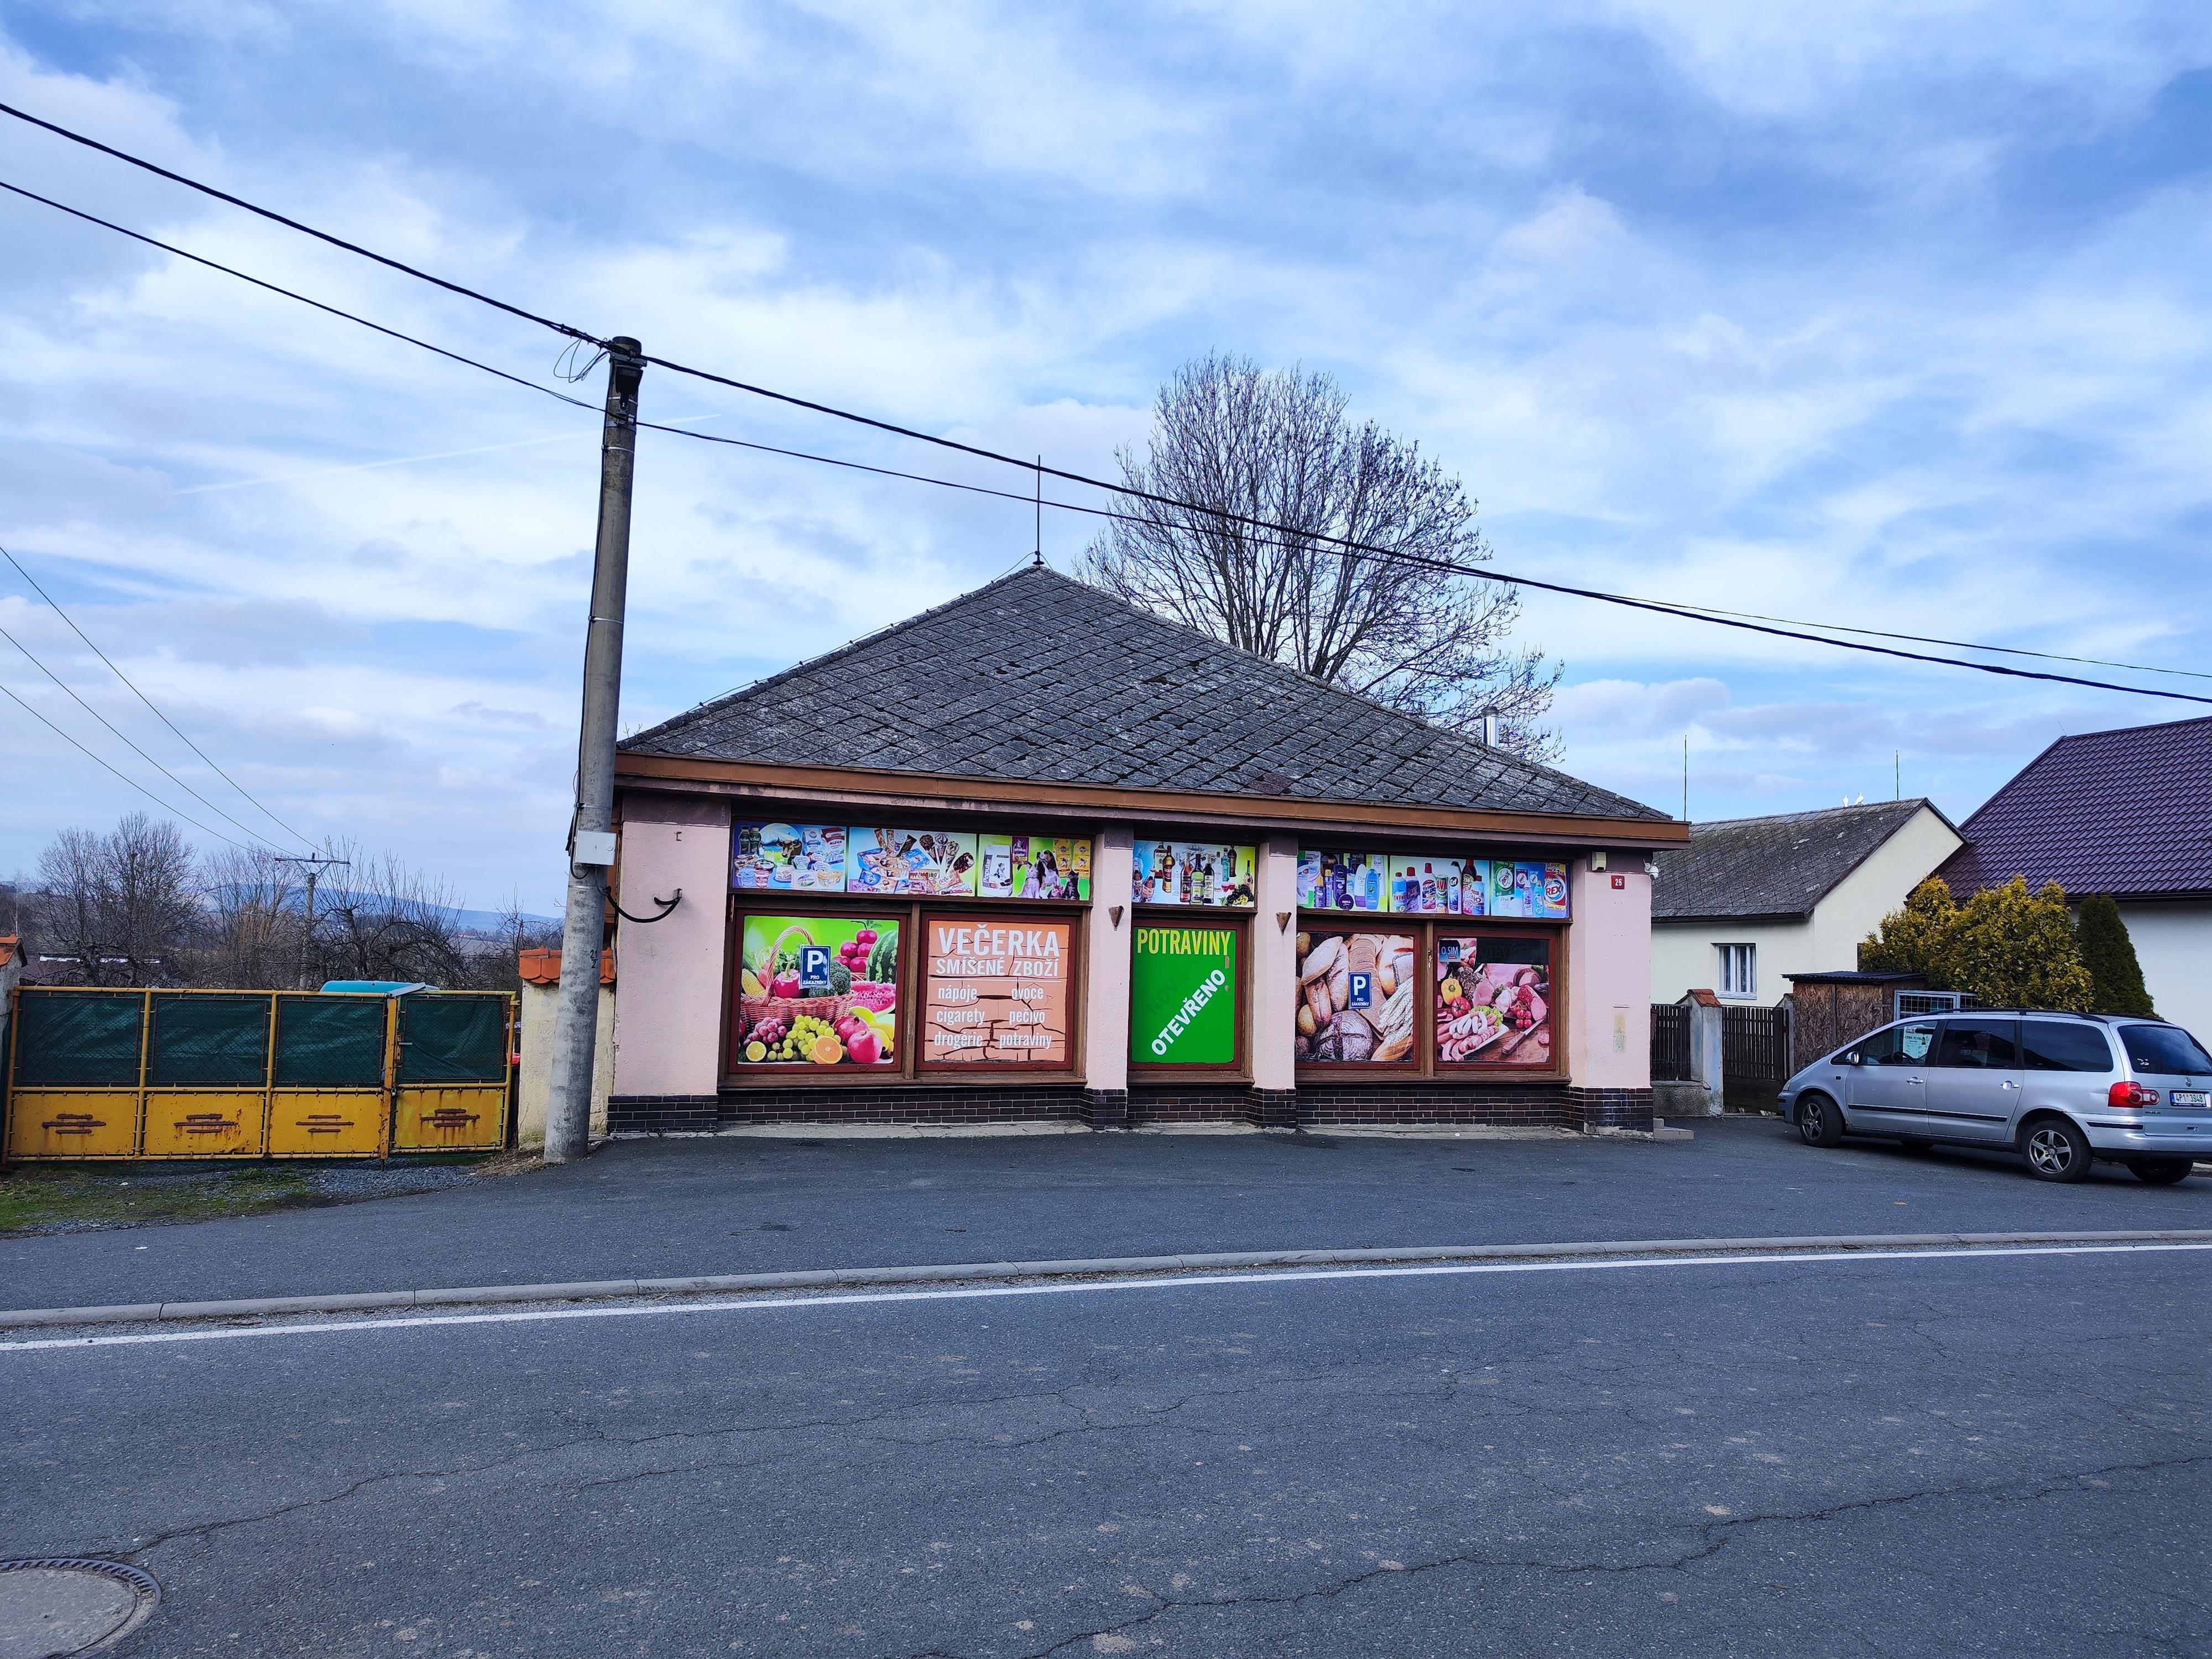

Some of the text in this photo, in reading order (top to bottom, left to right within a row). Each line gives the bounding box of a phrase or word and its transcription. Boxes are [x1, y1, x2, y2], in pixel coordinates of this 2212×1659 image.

[1546, 885, 1561, 895] REX
[938, 924, 1060, 957] VEČERKA
[1138, 929, 1231, 956] POTRAVINY
[590, 949, 597, 959] 21
[1448, 946, 1458, 955] SIM
[807, 950, 823, 972] P
[936, 956, 1059, 977] SMÍŠENÉ ZBOŽÍ
[938, 985, 1044, 1003] nápoje ovoce
[1354, 976, 1366, 995] P
[936, 1008, 1045, 1026] cigarety pečivo
[1151, 969, 1225, 1055] OTEVŘENO
[934, 1031, 1052, 1049] drogérie potraviny
[2176, 1094, 2187, 1102] 4P1
